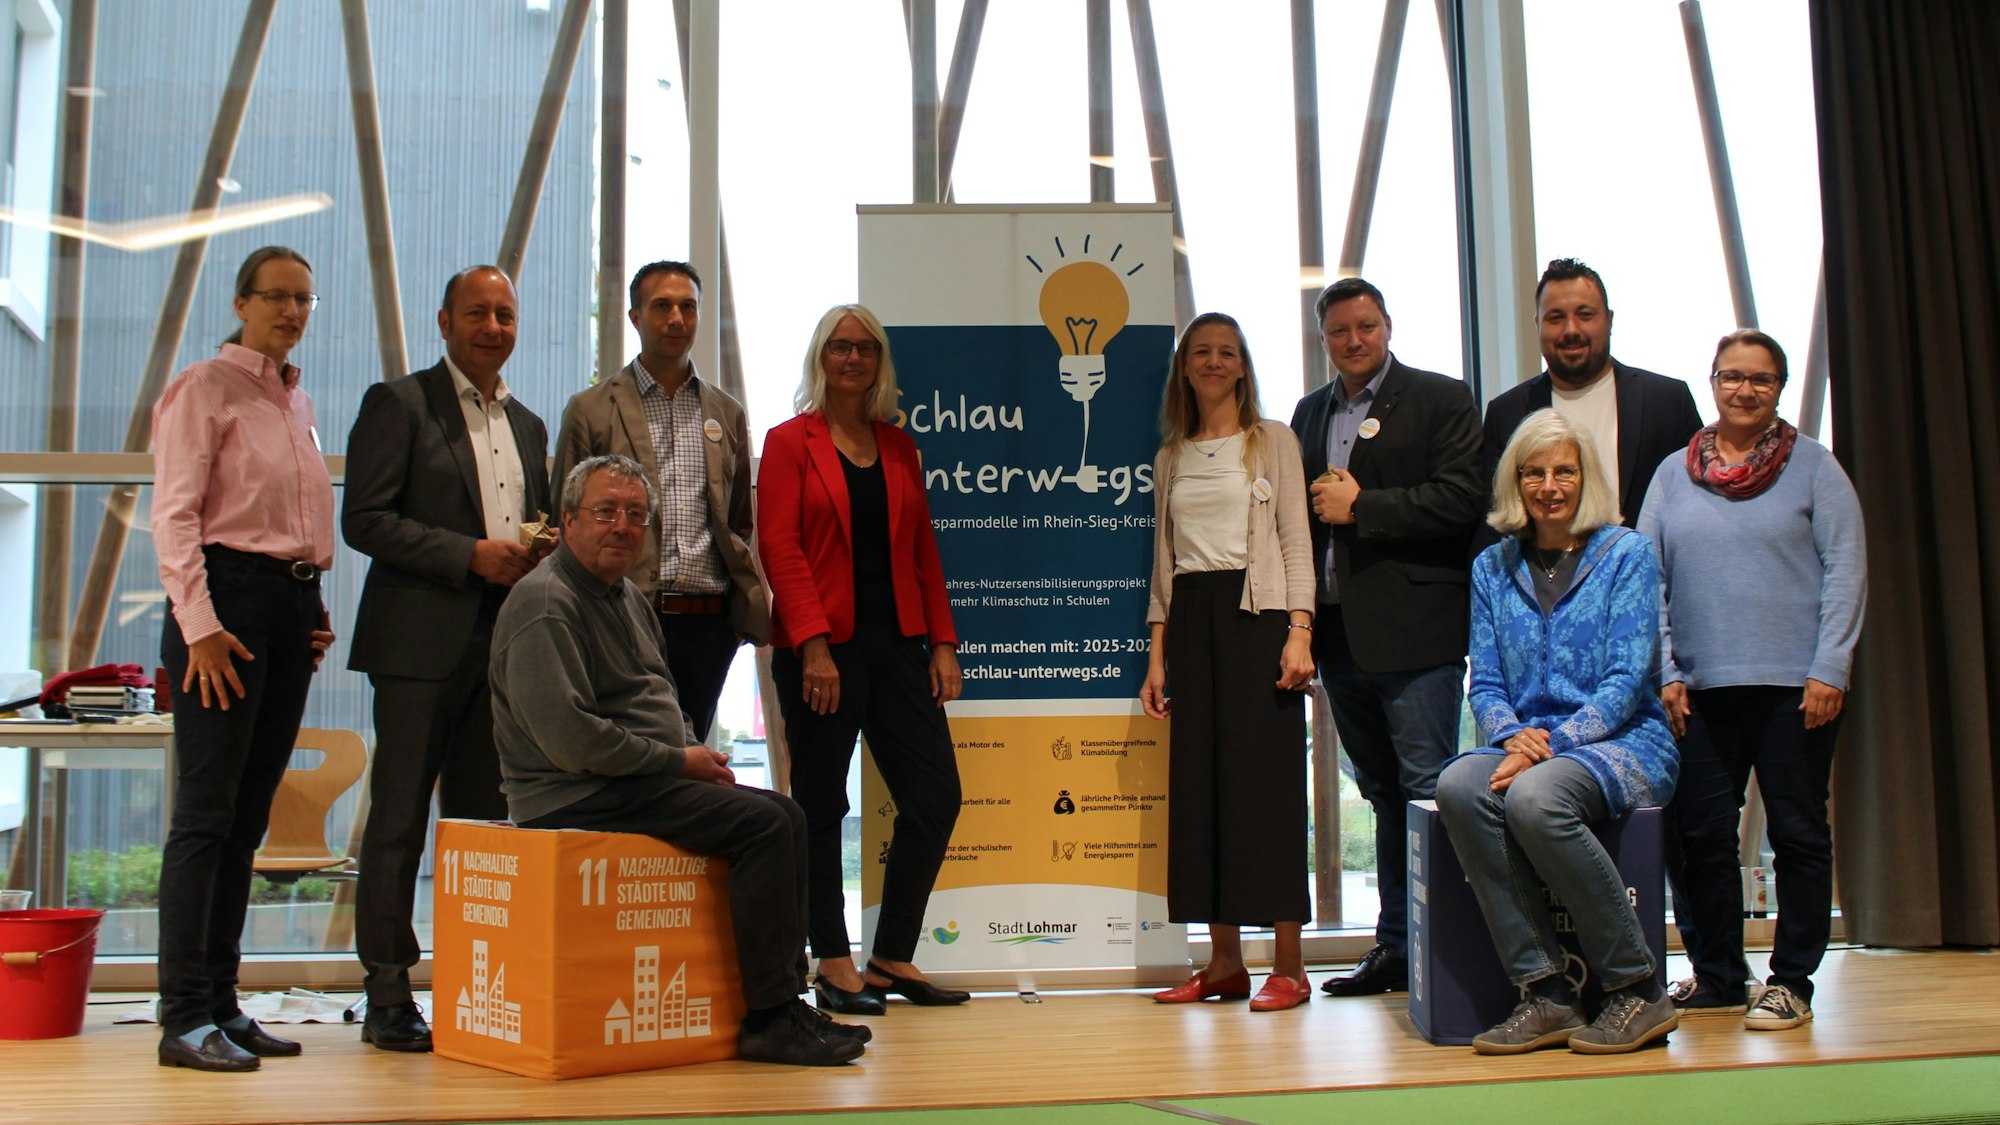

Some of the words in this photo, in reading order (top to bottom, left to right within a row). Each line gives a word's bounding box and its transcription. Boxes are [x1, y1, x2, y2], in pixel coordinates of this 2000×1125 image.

[1022, 515, 1039, 528] im
[1044, 514, 1156, 531] Rhein-Sieg-Kreis
[945, 577, 1146, 591] ahres-Nutzersensibilisierungsprojekt
[950, 596, 979, 607] mehr
[982, 595, 1049, 607] Klimaschutz
[1053, 595, 1063, 606] in
[1066, 594, 1110, 606] Schulen
[955, 641, 987, 654] ulen
[991, 640, 1047, 654] machen
[1050, 639, 1079, 653] mit:
[1083, 638, 1152, 653] 2025-202
[961, 664, 1121, 682] .schlau-unterwegs.de
[969, 741, 991, 749] Motor
[992, 741, 1005, 749] des
[1081, 739, 1156, 748] Klassenübergreifende
[1081, 749, 1128, 757] Klimabildung
[985, 797, 996, 806] für
[997, 798, 1012, 806] alle
[1080, 795, 1112, 803] Jährliche
[1113, 794, 1138, 802] Prämie
[1139, 794, 1166, 802] anhand
[1081, 804, 1126, 813] gesammelter
[1128, 803, 1153, 811] Punkte
[957, 844, 970, 852] der
[971, 843, 1013, 852] schulischen
[1083, 842, 1102, 850] Viele
[1103, 842, 1140, 850] Hilfsmittel
[1142, 842, 1158, 850] zum
[1084, 851, 1134, 860] Energiesparen
[442, 849, 459, 895] 11
[464, 850, 519, 876] NACHHALTIGE
[464, 874, 493, 900] STÄDTE
[493, 880, 511, 902] UND
[578, 858, 608, 906] 11
[618, 856, 709, 878] NACHHALTIGE
[617, 880, 667, 904] STÄDTE
[669, 881, 696, 902] UND
[463, 902, 508, 928] GEMEINDEN
[616, 907, 691, 931] GEMEINDEN
[988, 921, 1023, 935] Stadt
[1026, 920, 1078, 934] Lohmar
